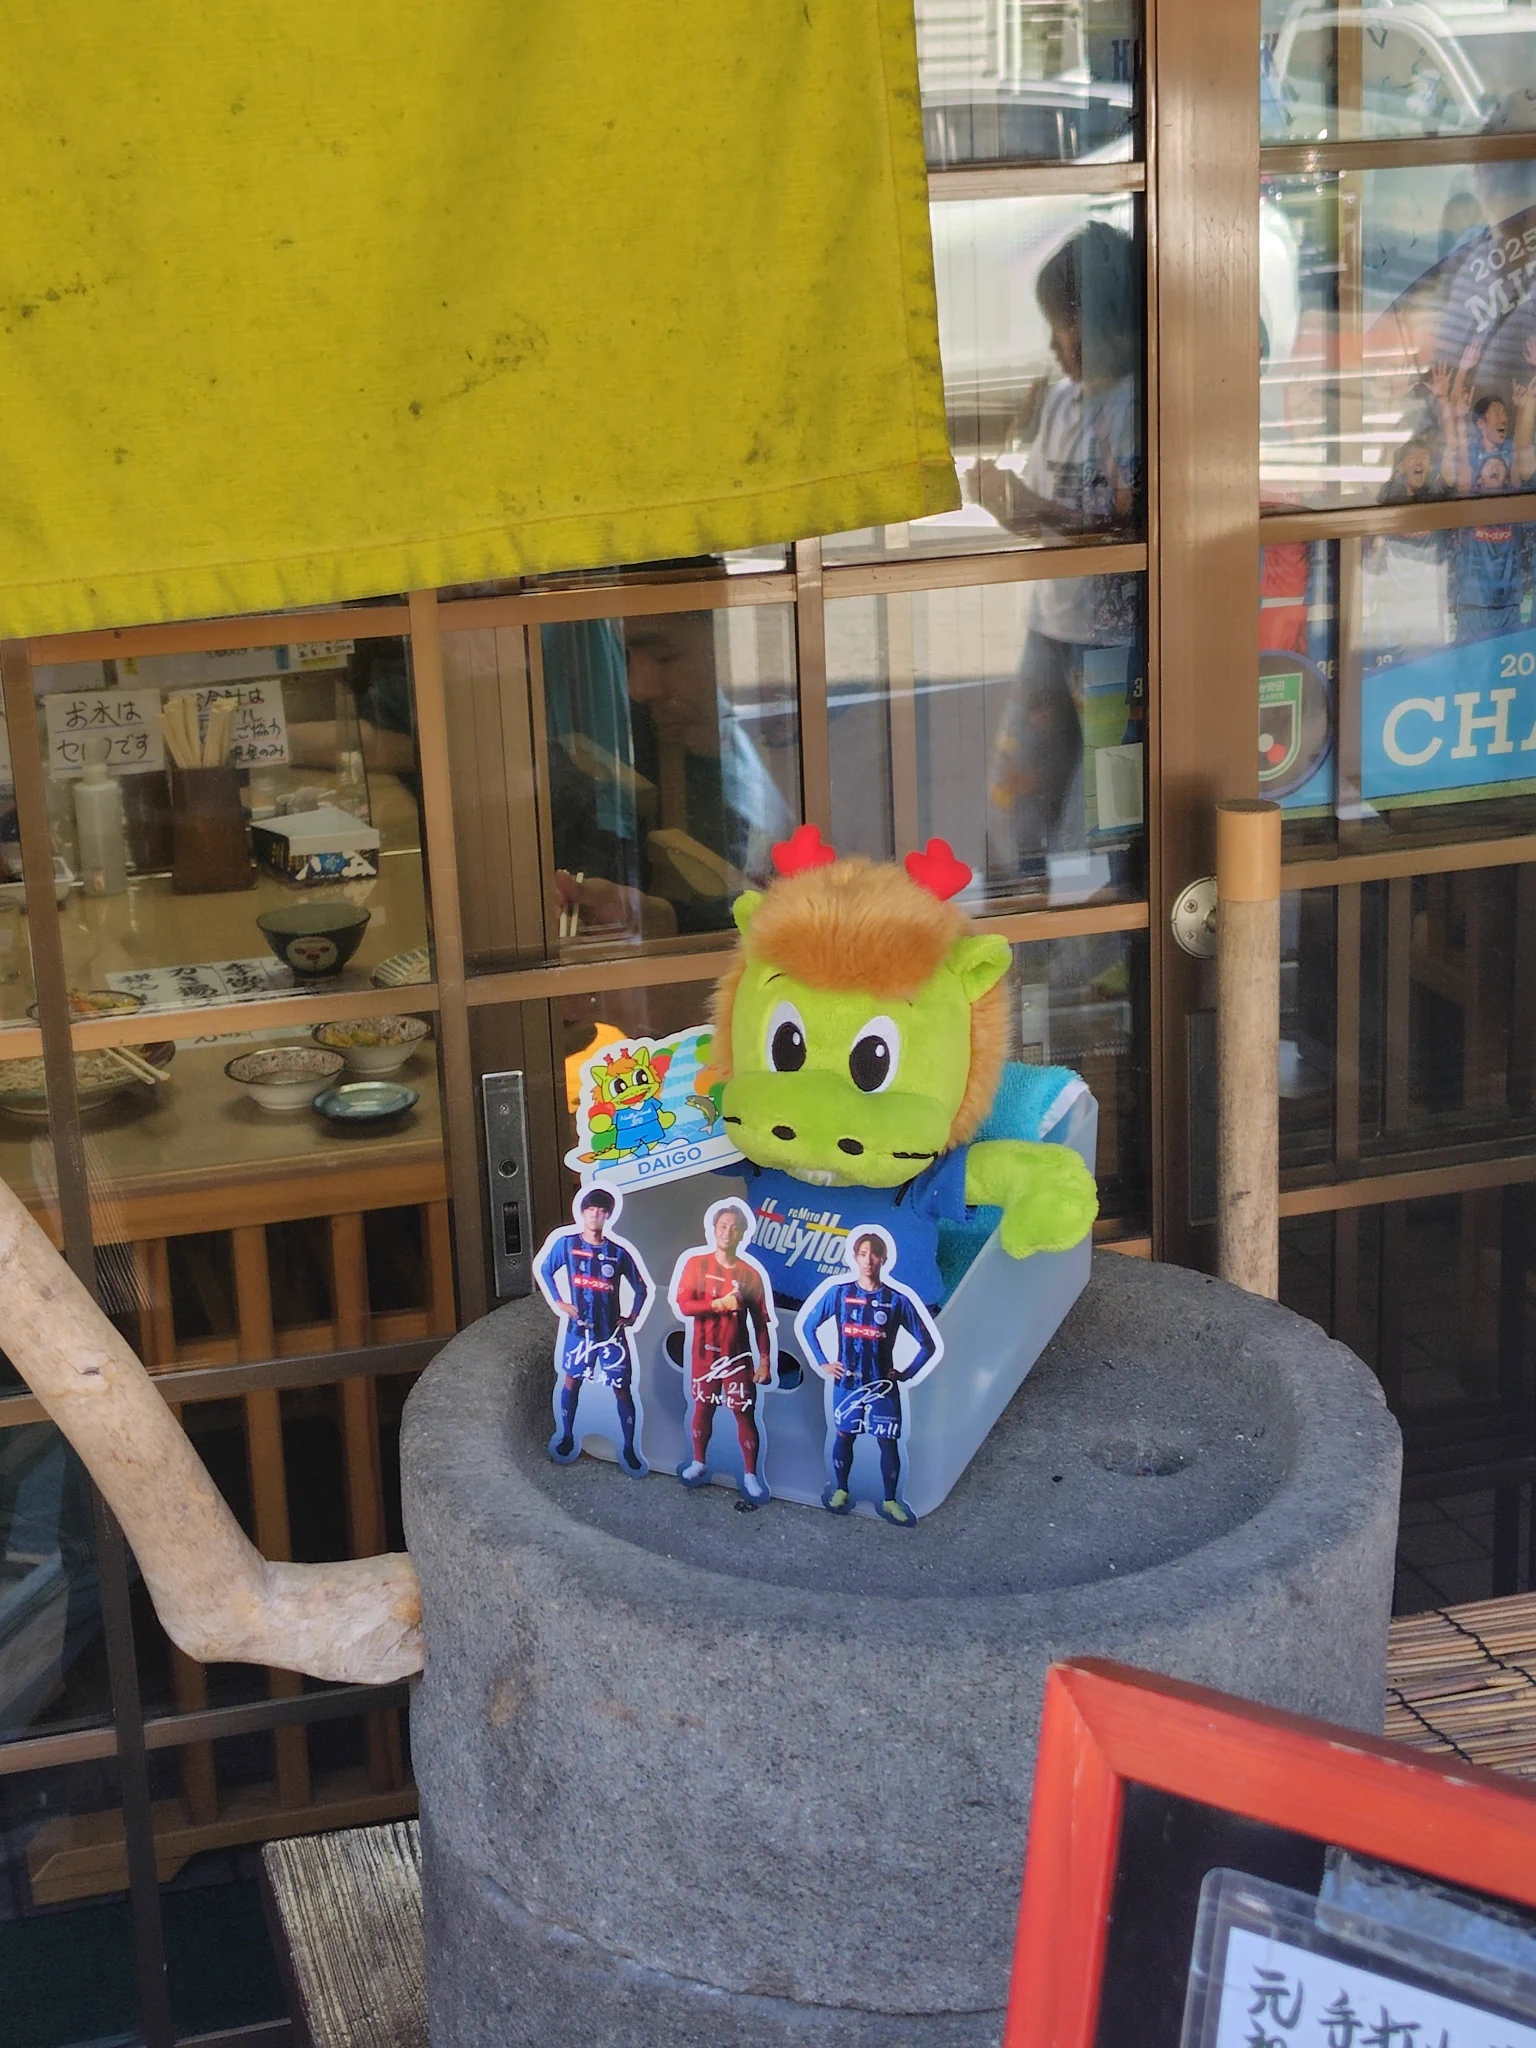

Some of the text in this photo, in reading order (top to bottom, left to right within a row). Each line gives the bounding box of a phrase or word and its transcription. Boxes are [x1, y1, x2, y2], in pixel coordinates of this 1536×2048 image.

[66, 700, 142, 728] お水は
[1383, 687, 1536, 767] CH
[638, 1147, 702, 1175] DAIGO
